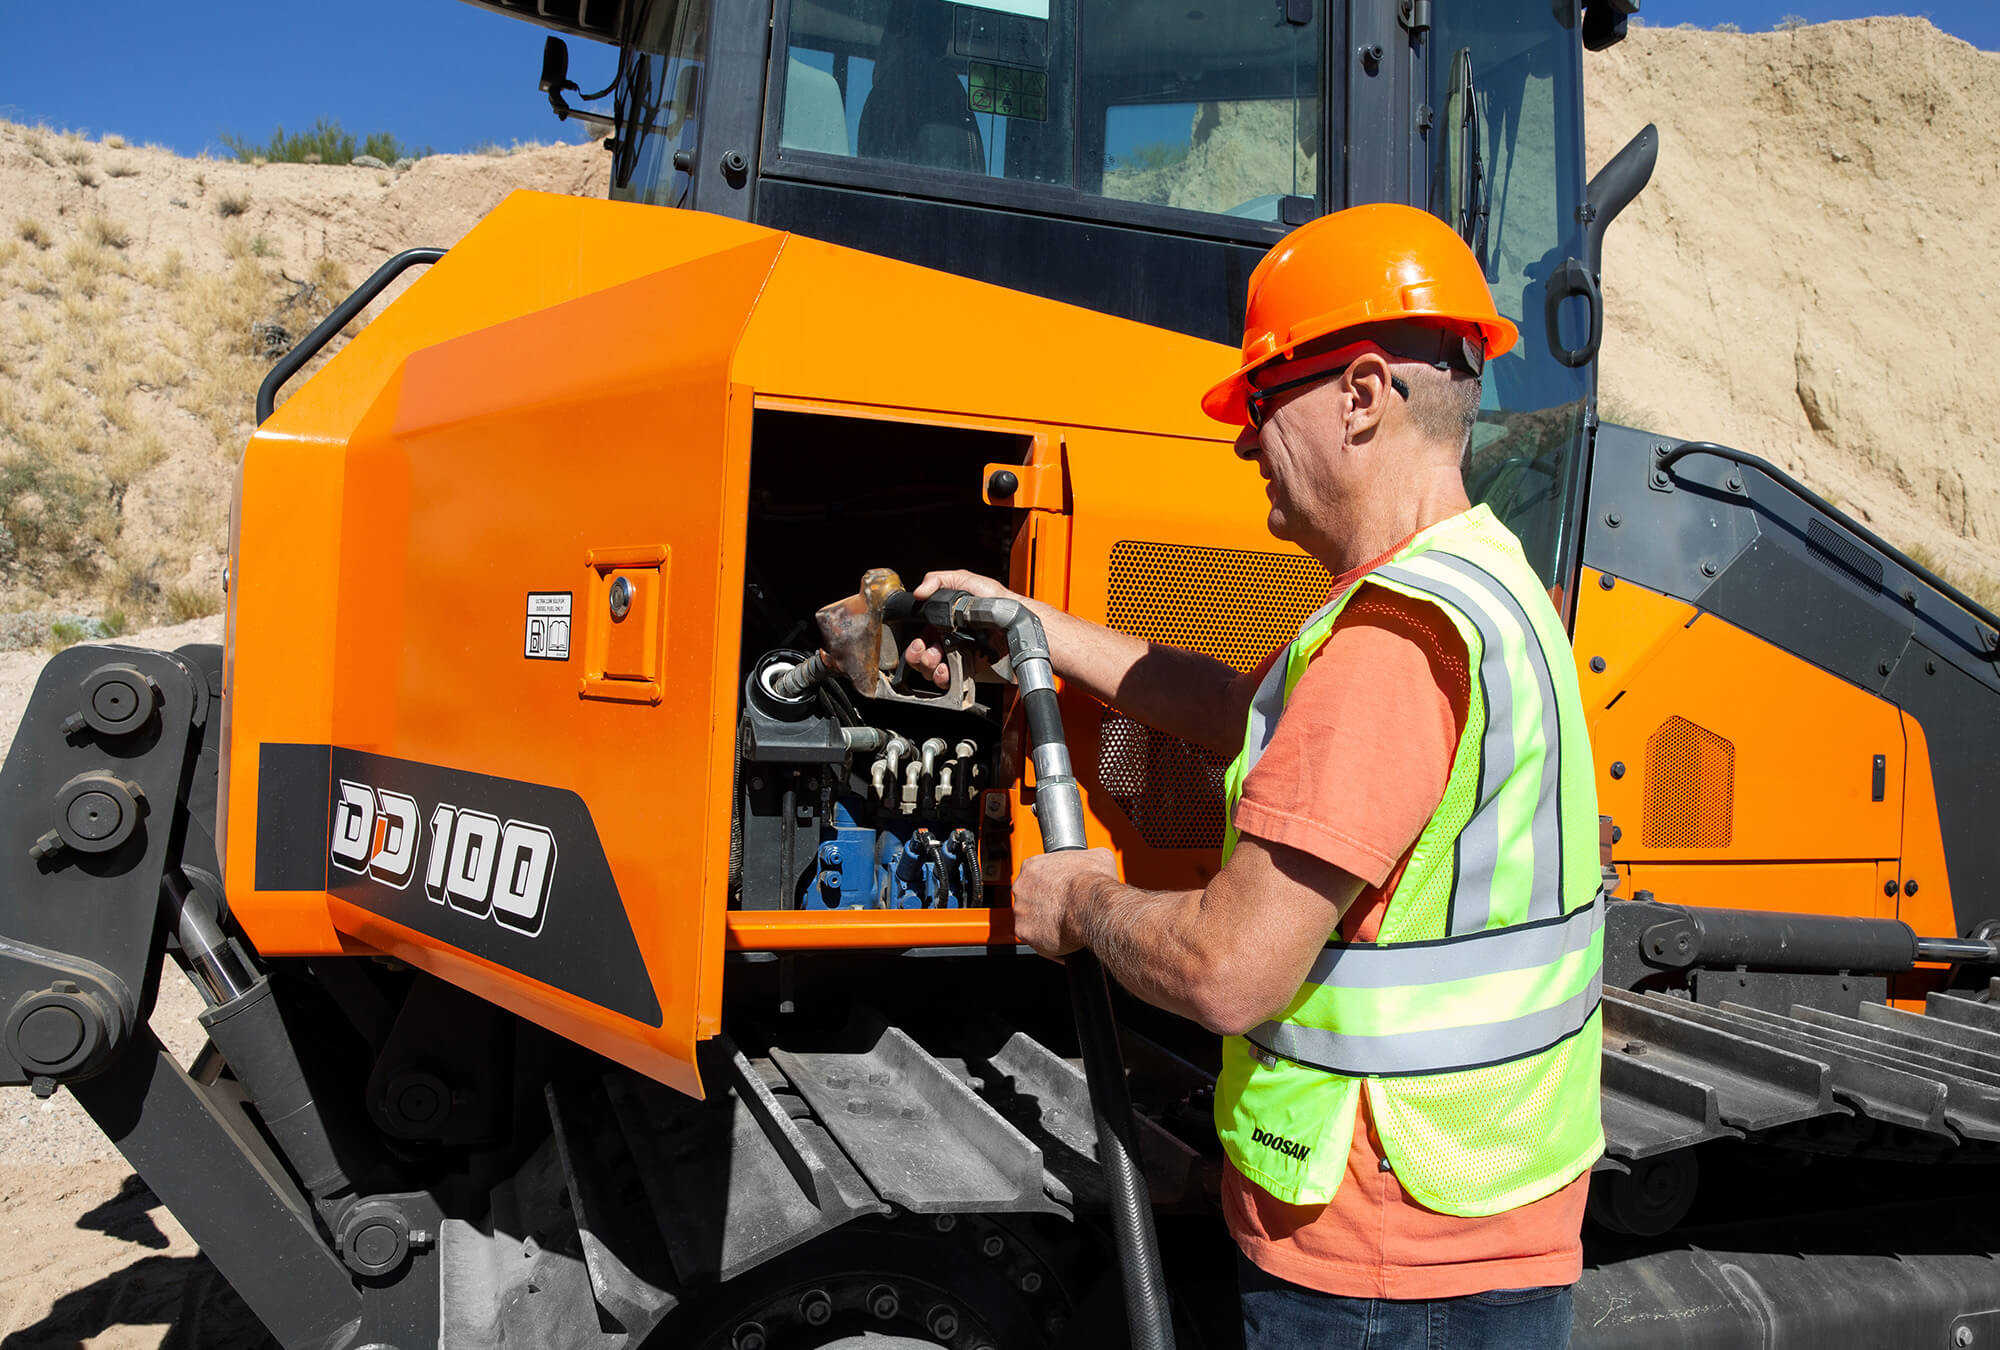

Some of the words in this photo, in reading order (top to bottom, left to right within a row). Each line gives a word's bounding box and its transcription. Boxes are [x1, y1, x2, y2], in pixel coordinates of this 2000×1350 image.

[331, 779, 421, 890] DD
[425, 802, 558, 938] 100
[1251, 1127, 1311, 1162] DOOSAN
